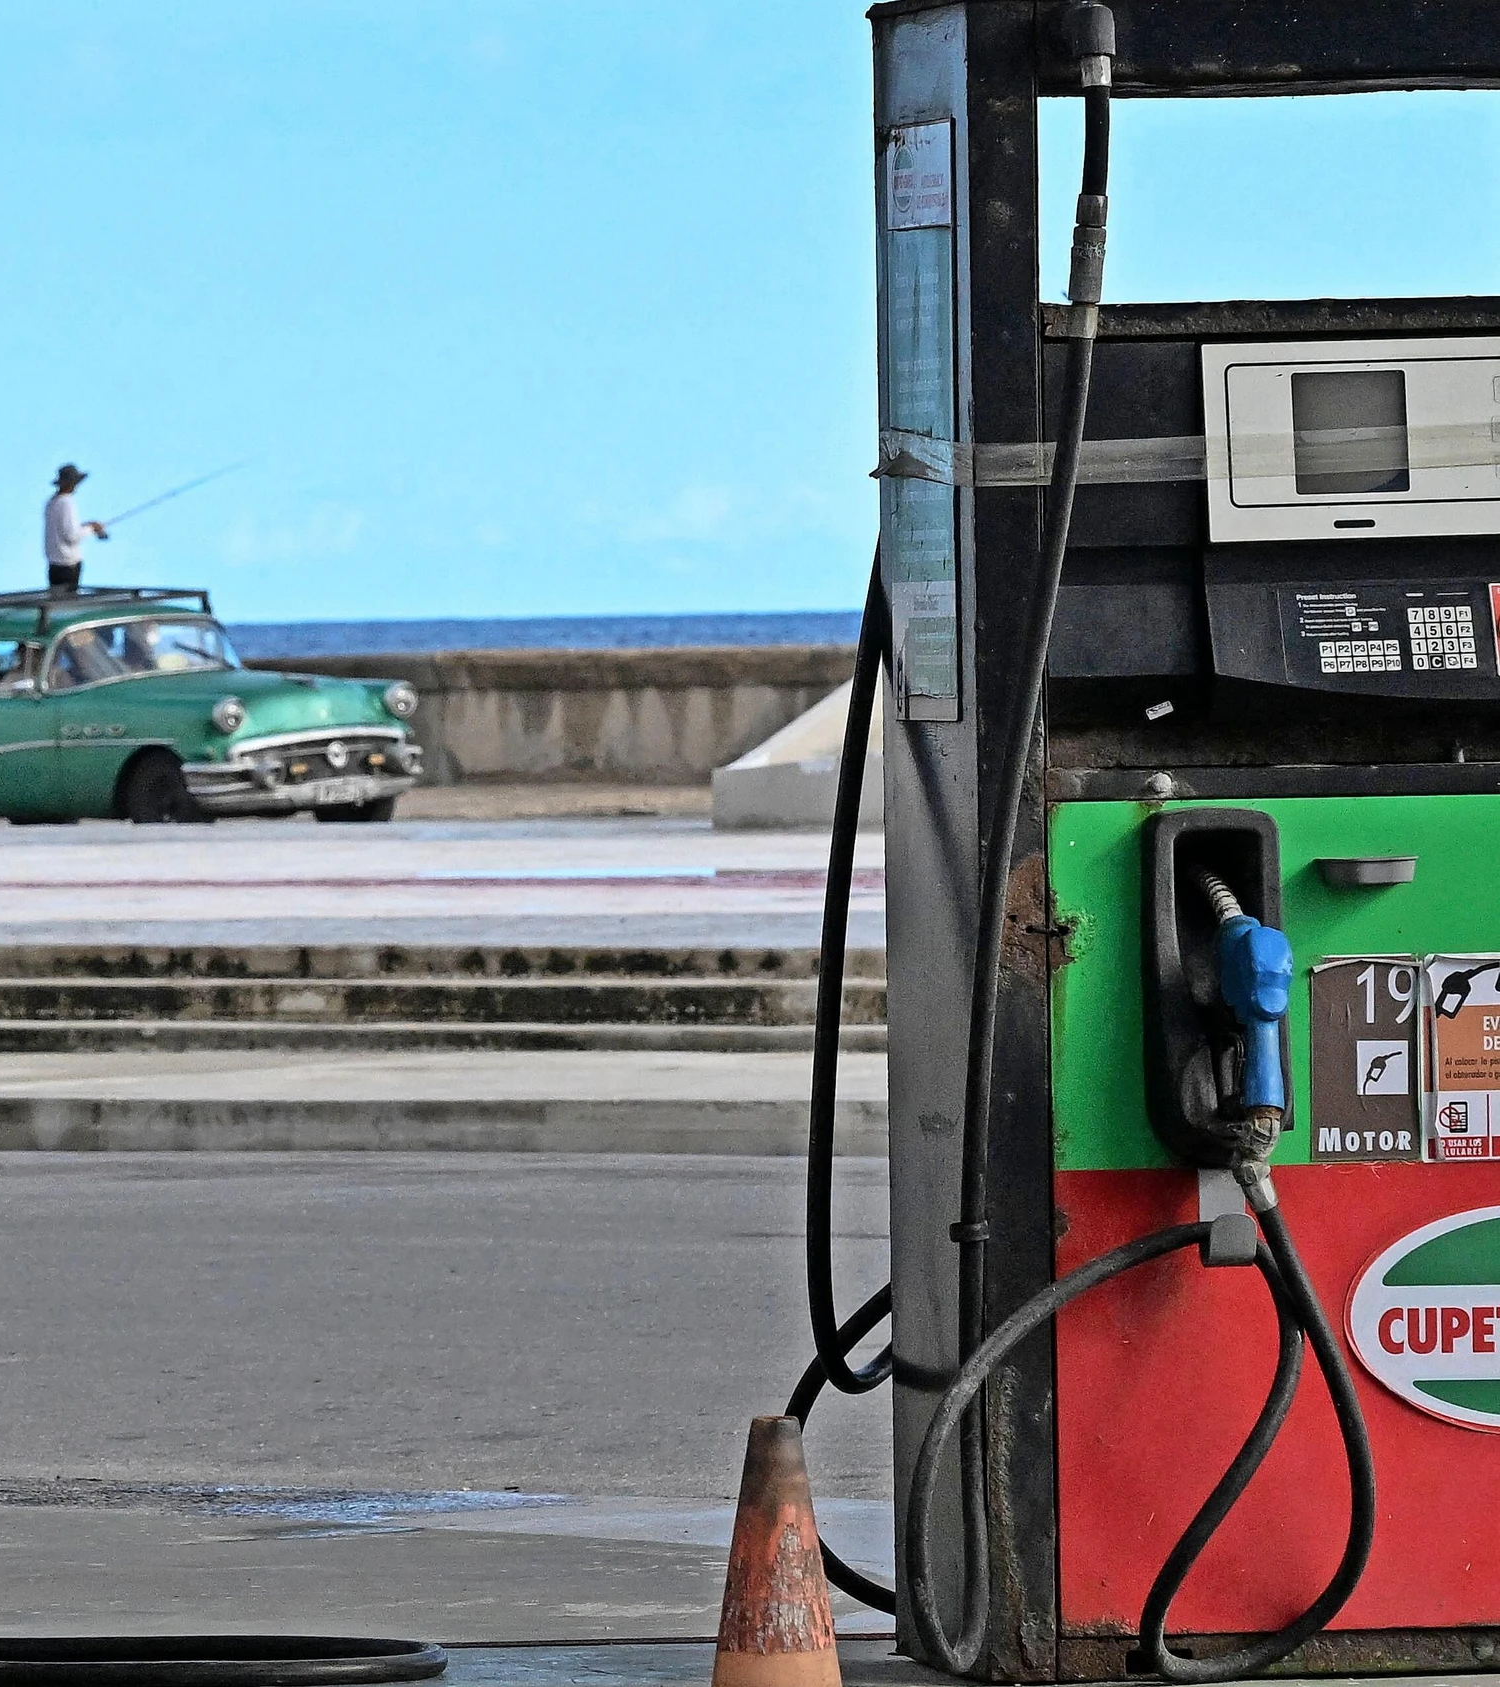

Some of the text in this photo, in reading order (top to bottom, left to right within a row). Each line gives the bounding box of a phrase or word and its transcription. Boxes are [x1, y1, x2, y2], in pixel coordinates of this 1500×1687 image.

[1412, 610, 1419, 620] 7
[1428, 610, 1435, 620] 8
[1444, 609, 1451, 619] 9
[1414, 626, 1421, 636] 4
[1430, 626, 1437, 636] 5
[1446, 625, 1453, 635] 6
[1338, 645, 1349, 653] P2
[1416, 642, 1421, 651] 1
[1431, 641, 1439, 651] 2
[1448, 641, 1455, 651] 3
[1324, 661, 1335, 669] P6
[1356, 660, 1367, 668] P8
[1417, 658, 1424, 667] 0
[1432, 657, 1442, 667] C
[1356, 964, 1415, 1024] 19
[1445, 1057, 1452, 1065] Al
[1318, 1127, 1412, 1152] MOTOR
[1448, 1139, 1467, 1147] USAR
[1469, 1138, 1482, 1147] LOS
[1443, 1147, 1482, 1156] LULARES
